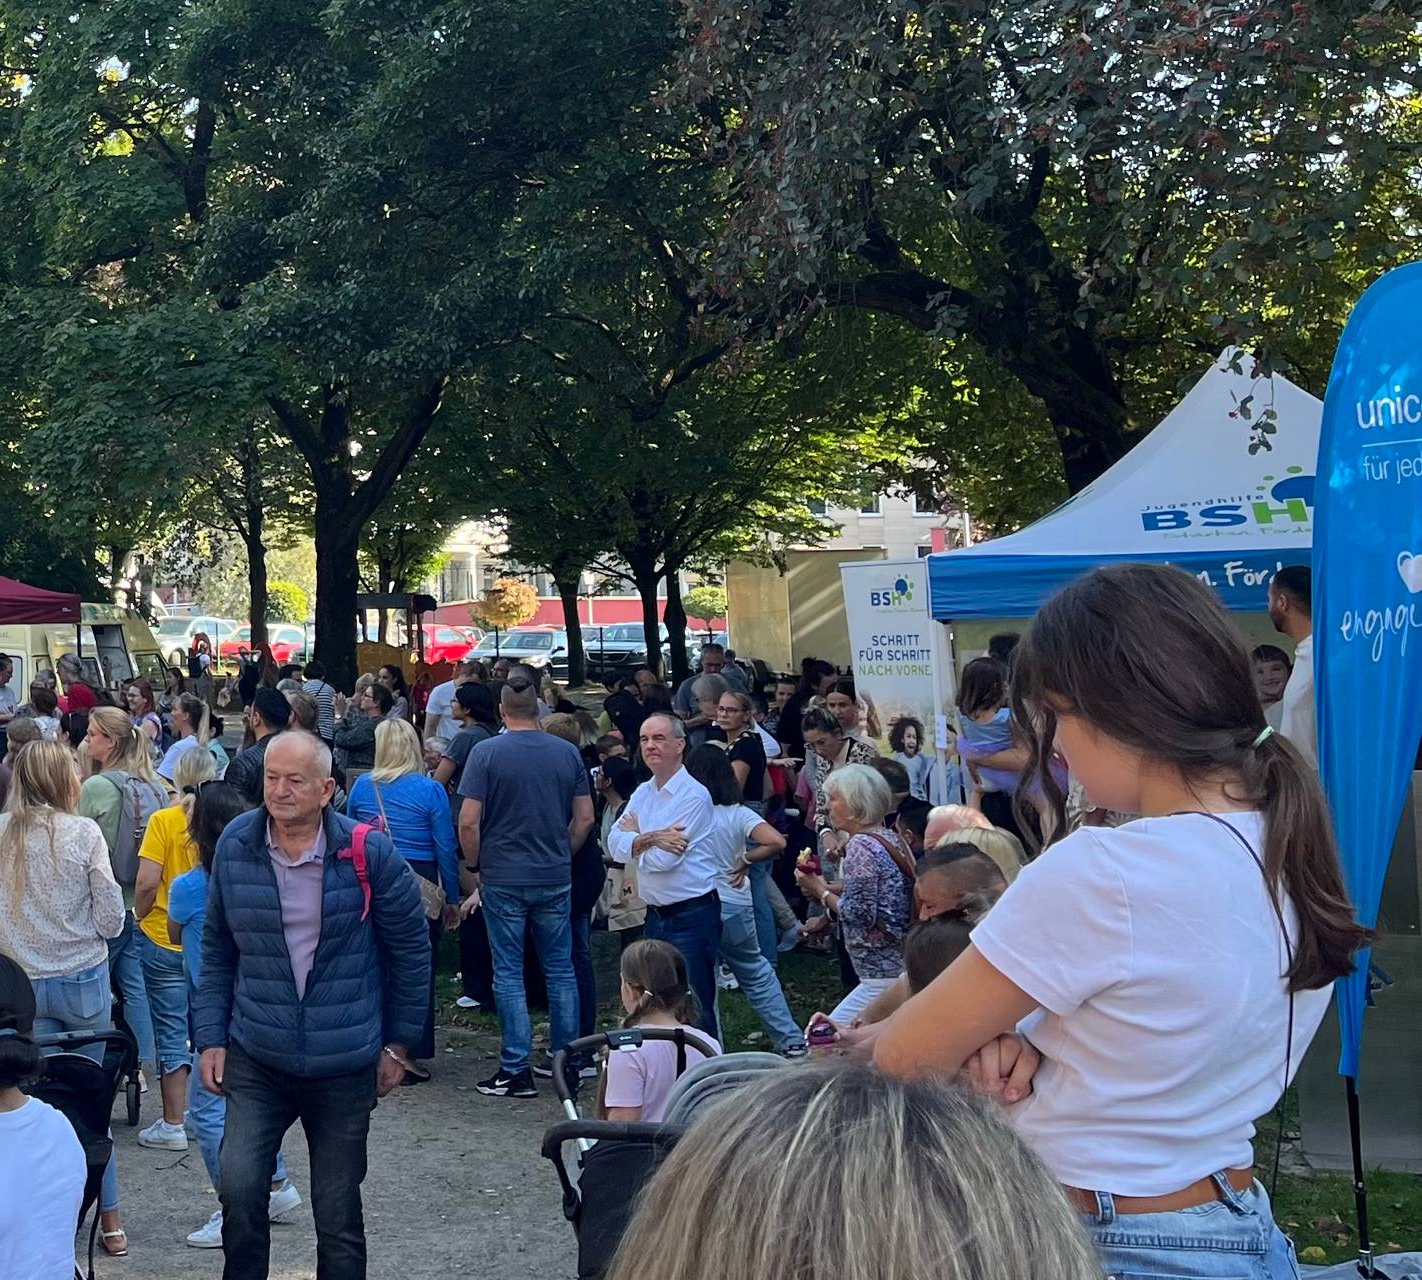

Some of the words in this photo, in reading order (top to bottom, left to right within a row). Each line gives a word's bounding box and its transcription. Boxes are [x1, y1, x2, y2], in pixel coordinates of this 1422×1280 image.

[1356, 385, 1422, 429] unic
[1363, 455, 1390, 480] für
[1141, 498, 1309, 531] BSH
[870, 591, 902, 606] BSH
[871, 634, 920, 646] SCHRITT
[859, 648, 883, 661] FÜR
[887, 649, 931, 661] SCHRITT
[859, 665, 892, 676] NACH
